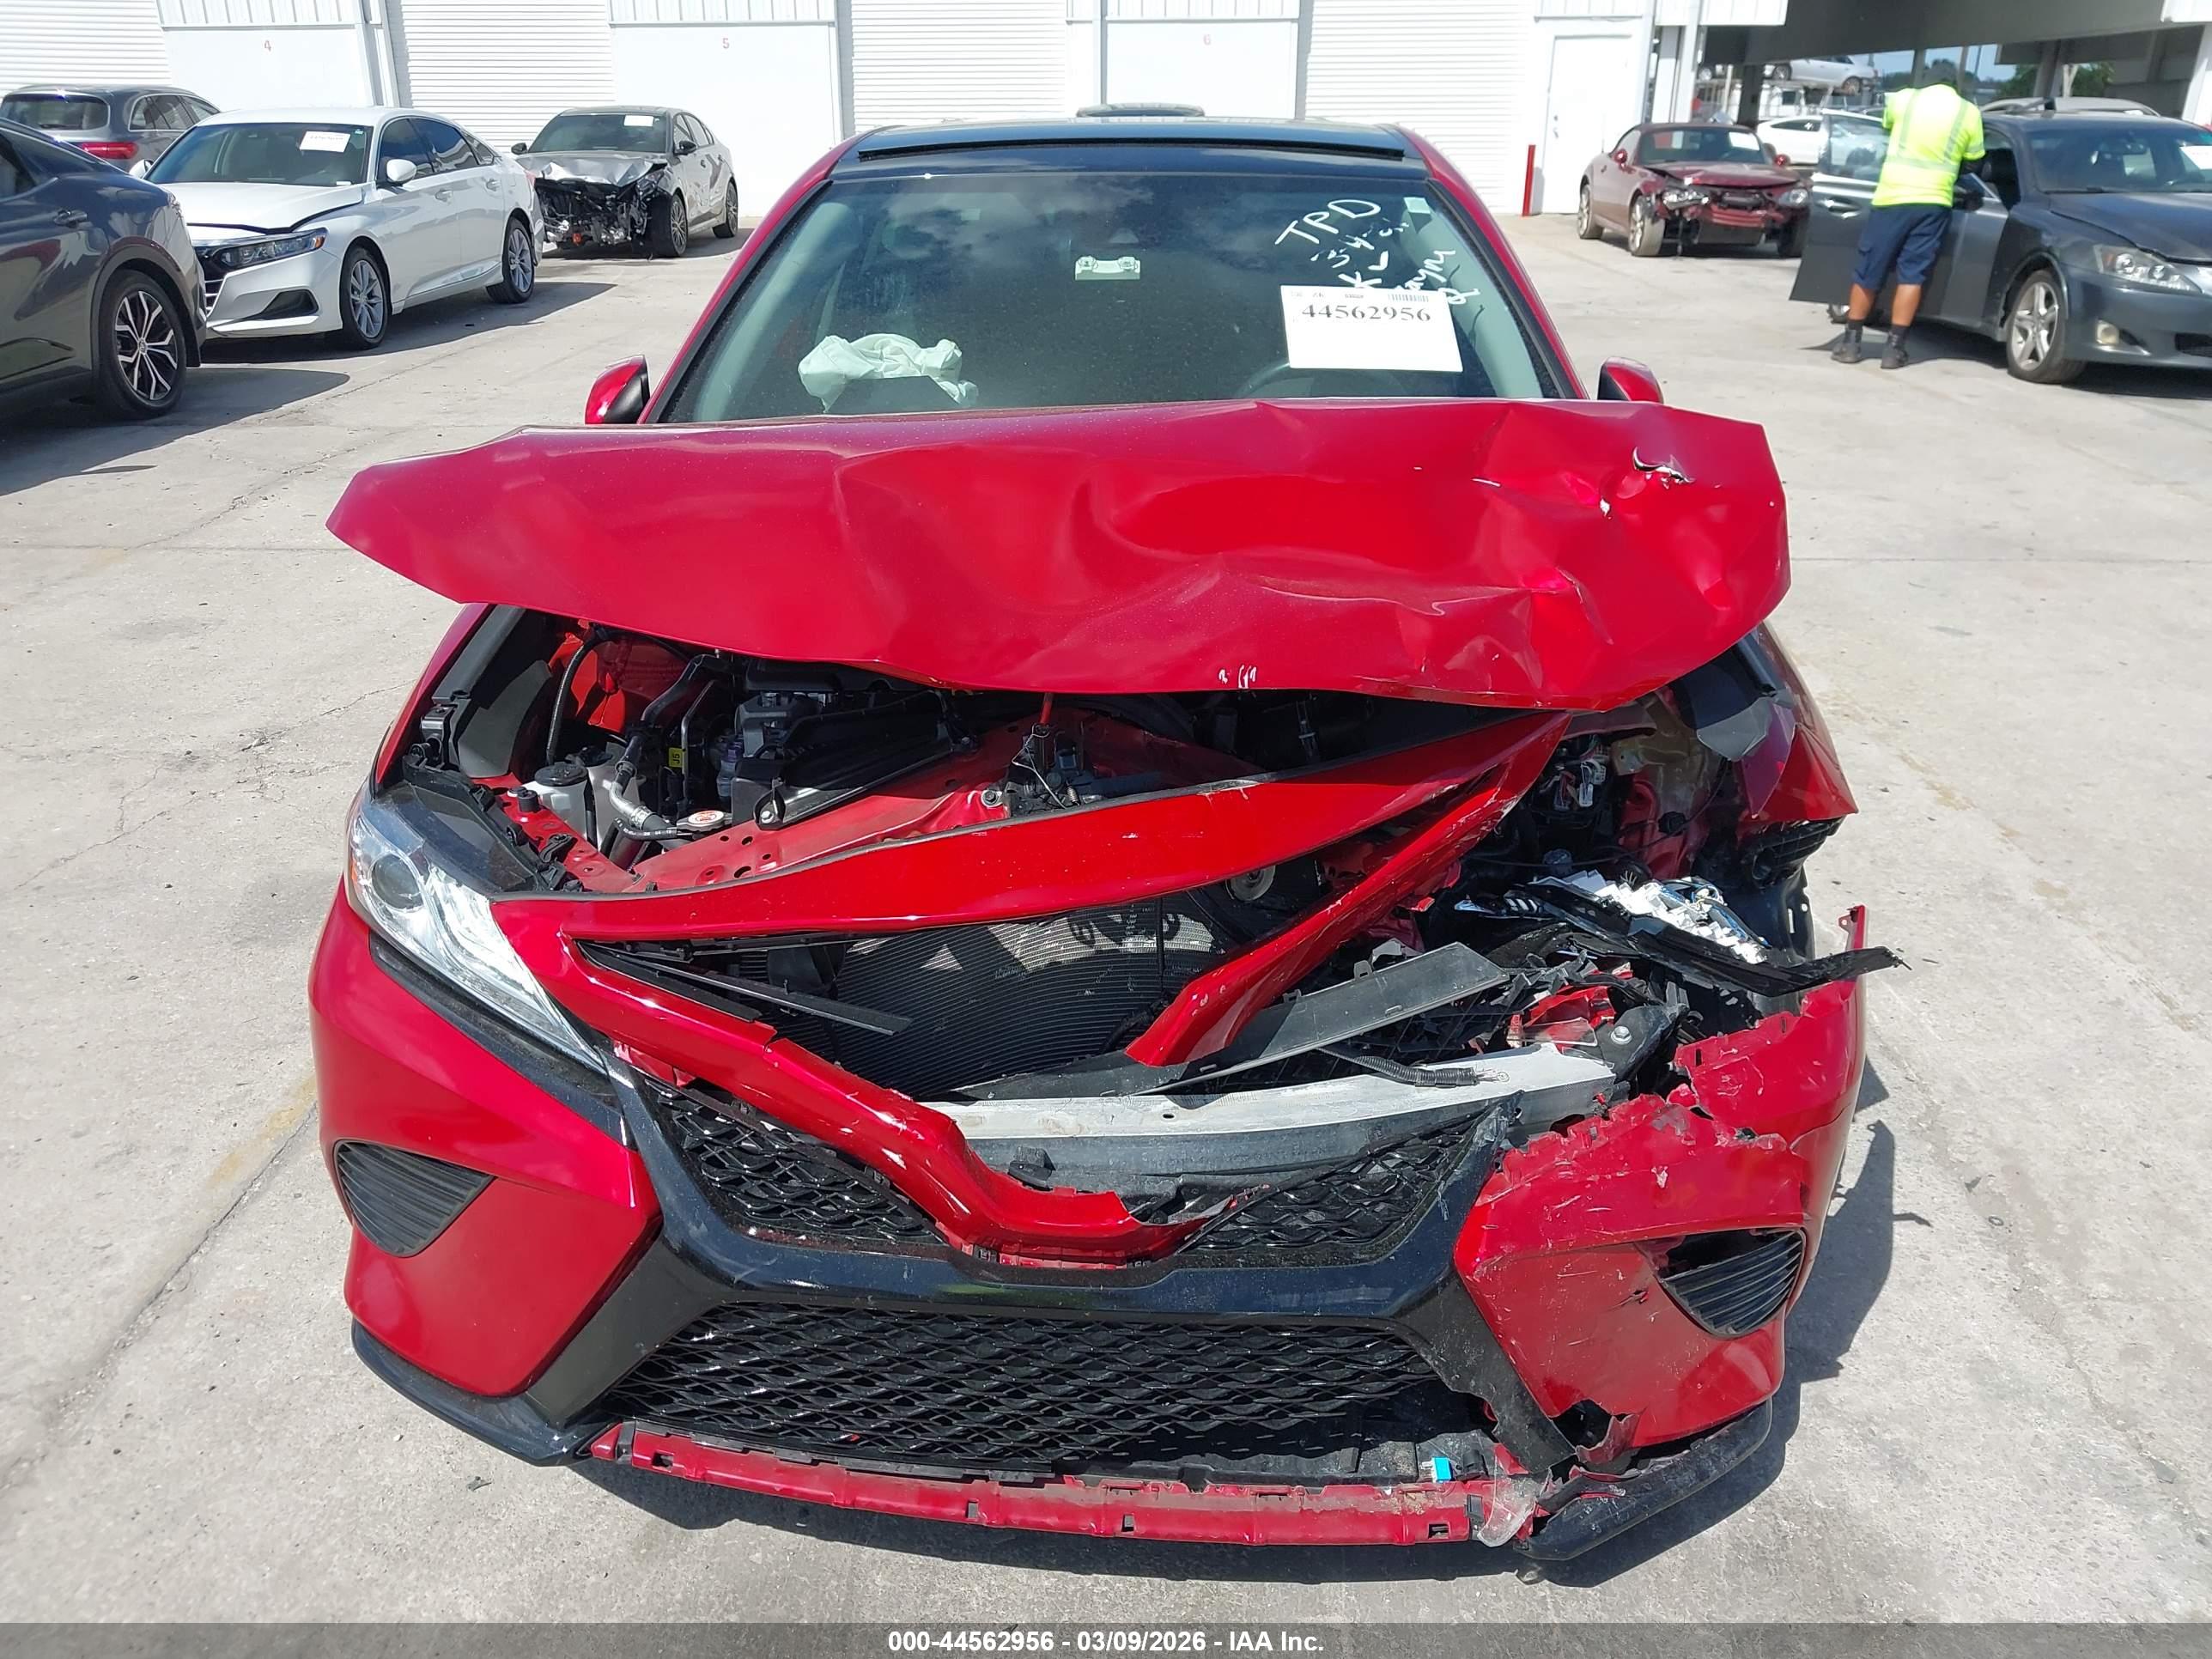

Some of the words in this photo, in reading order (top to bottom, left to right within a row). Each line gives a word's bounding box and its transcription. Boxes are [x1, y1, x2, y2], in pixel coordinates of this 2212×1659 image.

[264, 40, 271, 52] 4
[722, 37, 730, 49] 5
[1203, 33, 1211, 46] 6
[1274, 199, 1382, 245] TPD
[1302, 304, 1431, 322] 44562956
